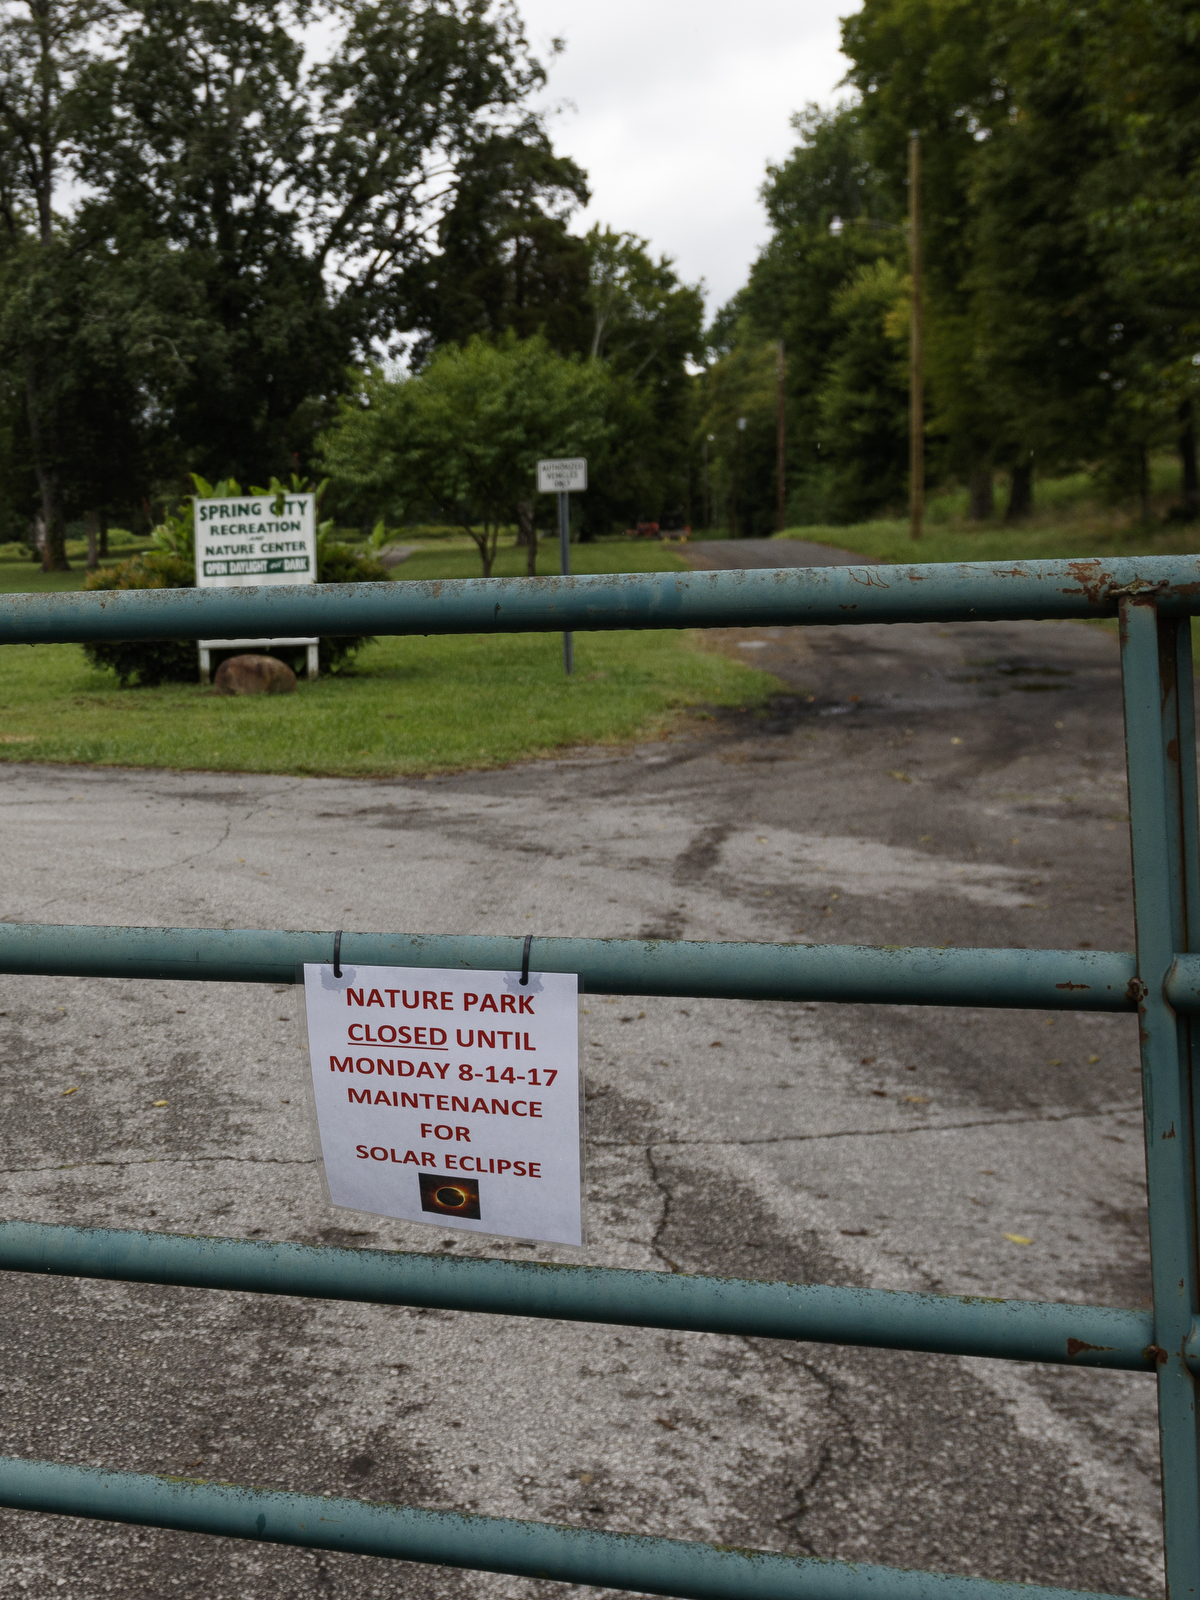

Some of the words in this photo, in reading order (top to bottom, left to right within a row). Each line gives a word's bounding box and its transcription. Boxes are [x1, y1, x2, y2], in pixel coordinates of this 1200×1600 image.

[200, 502, 261, 521] SPRING
[269, 500, 307, 516] CTY
[210, 521, 301, 536] RECREATION
[205, 544, 255, 556] NATURE
[260, 541, 307, 553] CENTER
[205, 562, 228, 575] OPEN
[229, 560, 268, 573] DAYLIGHT
[284, 557, 307, 571] DARK
[346, 987, 454, 1011] NATURE
[463, 992, 535, 1015] PARK
[348, 1023, 448, 1046] CLOSED
[456, 1028, 536, 1051] UNTIL
[329, 1055, 450, 1080] MONDAY
[458, 1063, 558, 1087] 8-14-17
[347, 1088, 543, 1118] MAINTENANCE
[420, 1122, 471, 1143] FOR
[356, 1144, 437, 1168] SOLAR
[444, 1154, 542, 1179] ECLIPSE
